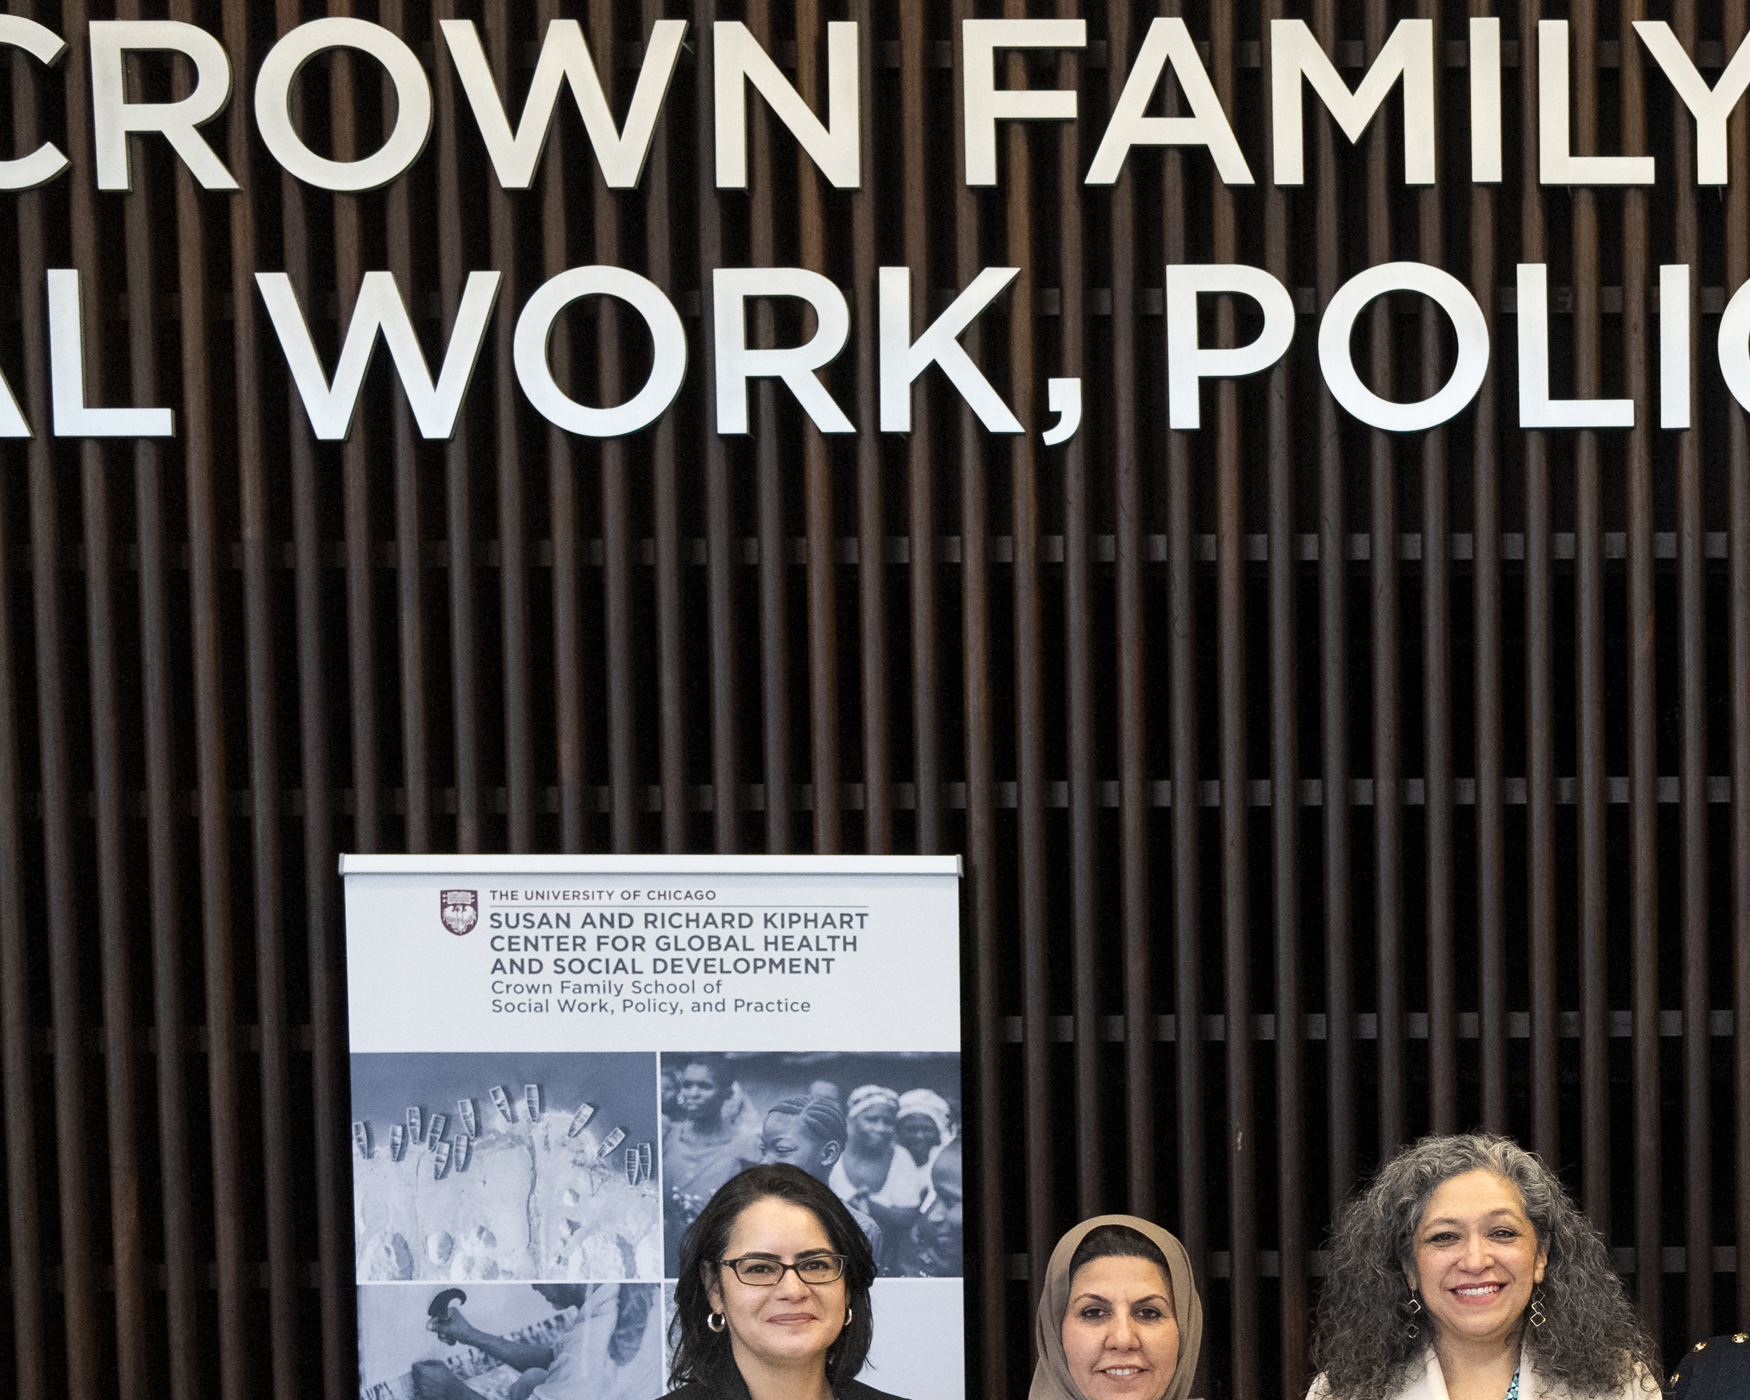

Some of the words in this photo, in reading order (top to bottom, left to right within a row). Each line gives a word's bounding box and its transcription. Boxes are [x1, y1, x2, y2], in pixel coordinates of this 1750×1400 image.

[0, 269, 172, 437] L
[254, 265, 1082, 445] WORK,
[489, 890, 519, 901] THE
[524, 890, 615, 901] UNIVERSITY
[620, 890, 641, 901] OF
[646, 889, 717, 901] CHICAGO
[489, 912, 571, 930] SUSAN
[580, 912, 635, 929] AND
[644, 912, 754, 930] RICHARD
[763, 912, 869, 930] KIPHART
[490, 935, 587, 952] CENTER
[596, 935, 646, 952] FOR
[655, 934, 755, 952] GLOBAL
[764, 935, 857, 952] HEALTH
[490, 957, 544, 975] AND
[553, 957, 644, 975] SOCIAL
[652, 957, 836, 975] DEVELOPMENT
[491, 980, 552, 995] Crown
[560, 979, 624, 998] Family
[631, 979, 695, 995] School
[703, 979, 723, 994] of
[491, 998, 549, 1013] Social
[556, 998, 615, 1015] Work,
[622, 998, 684, 1016] Policy,
[691, 998, 726, 1013] and
[734, 998, 811, 1013] Practice
